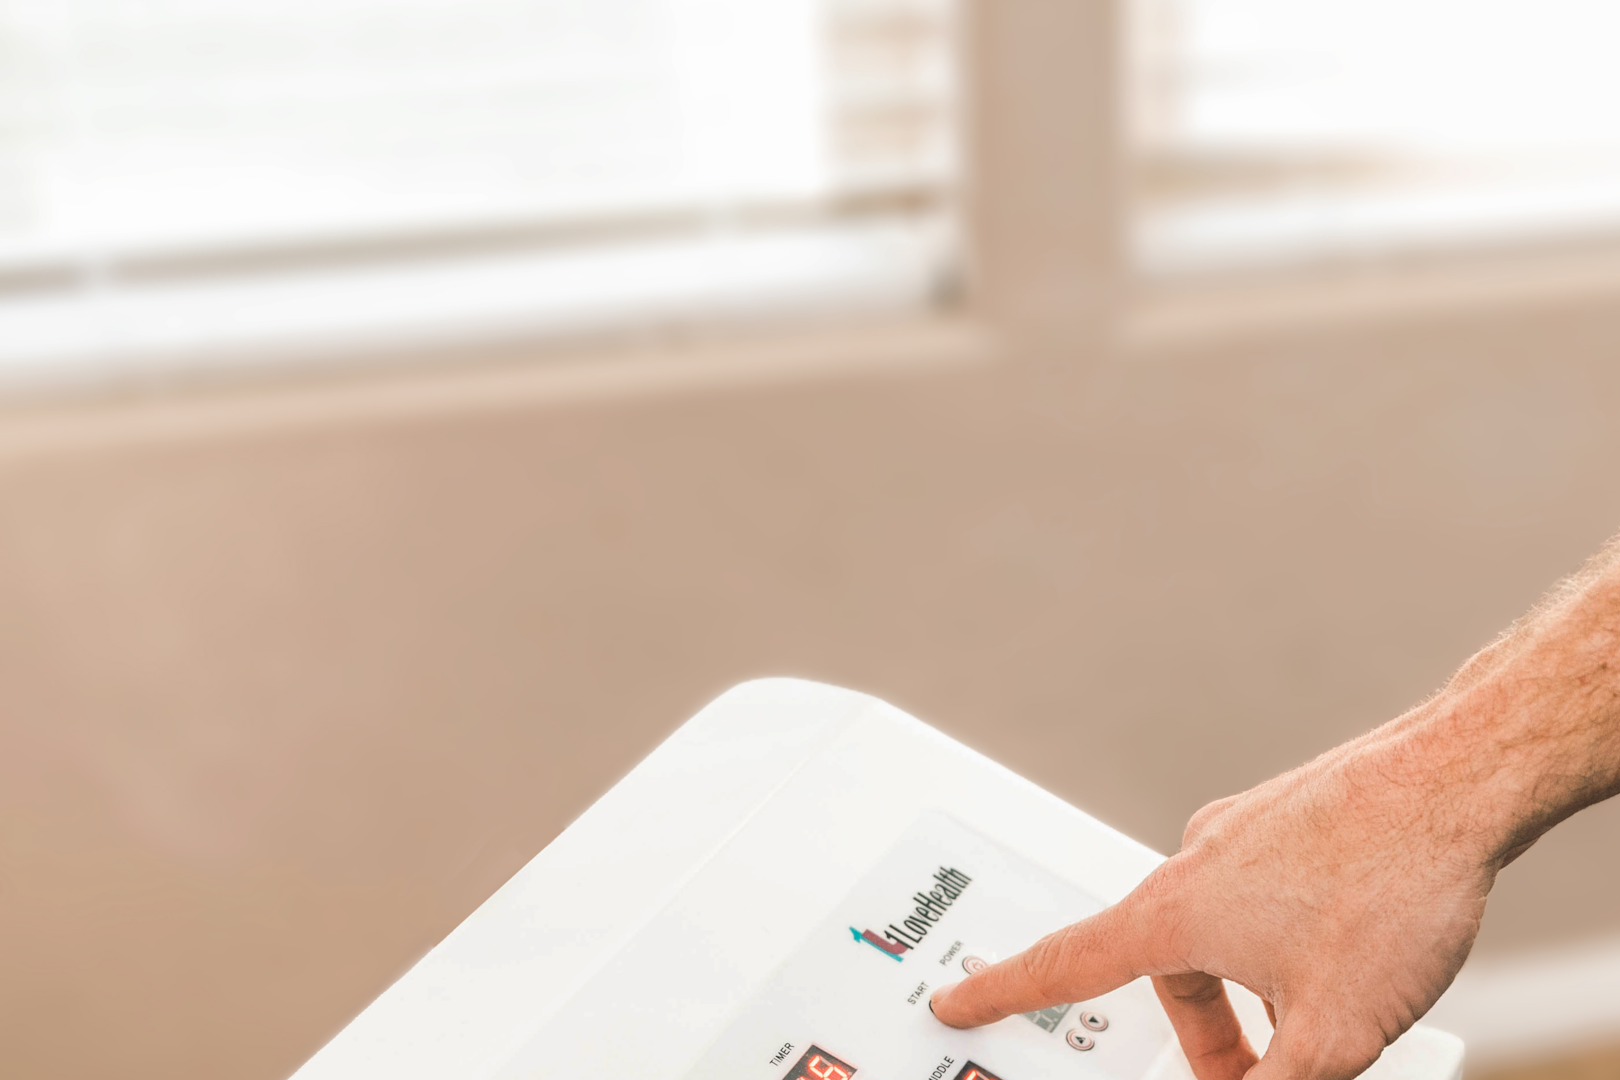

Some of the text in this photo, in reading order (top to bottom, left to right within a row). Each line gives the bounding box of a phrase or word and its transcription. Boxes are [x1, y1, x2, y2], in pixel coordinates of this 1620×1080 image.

[939, 940, 964, 966] POWER
[907, 981, 929, 1005] START
[769, 1042, 795, 1066] TIMER
